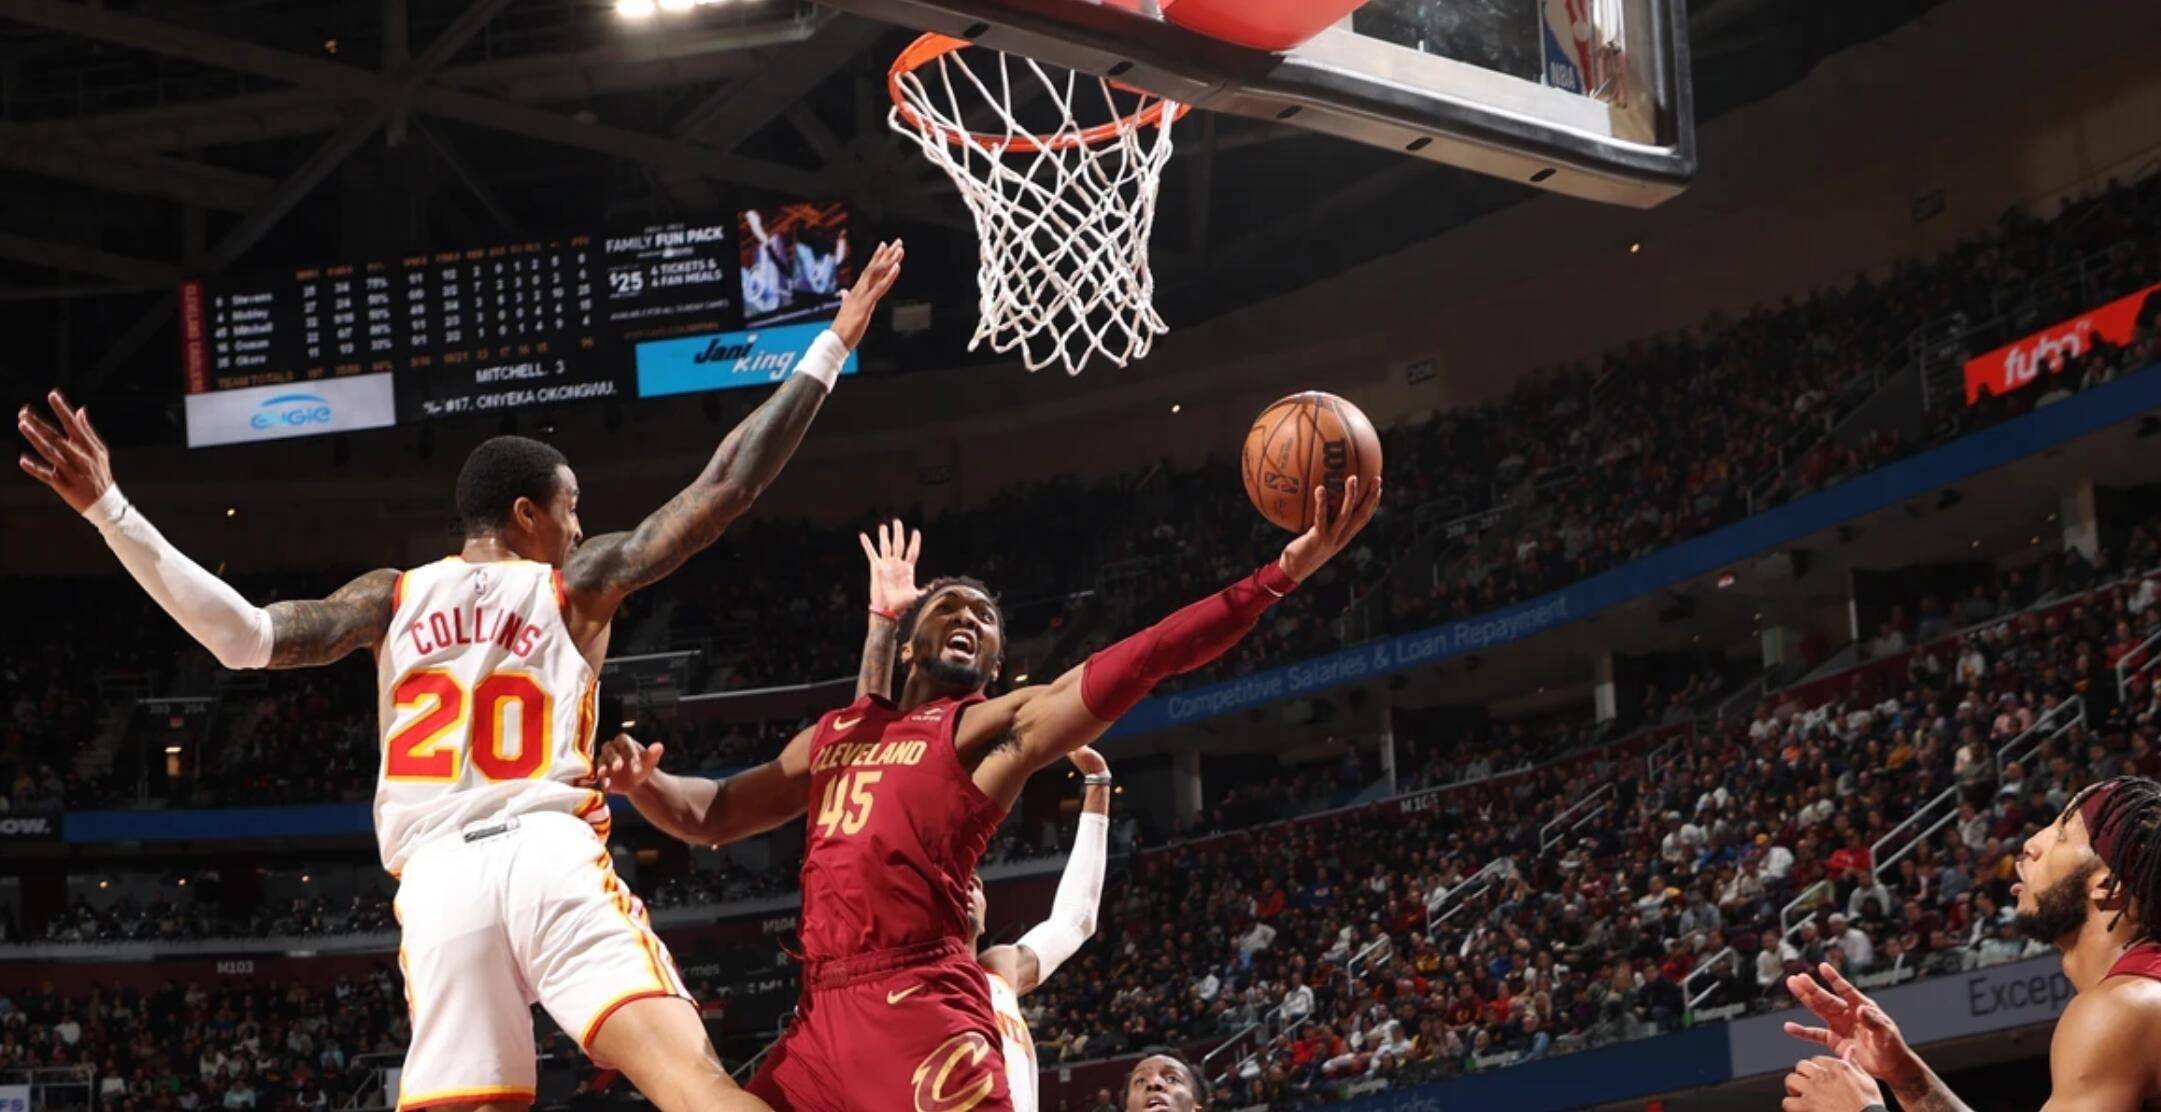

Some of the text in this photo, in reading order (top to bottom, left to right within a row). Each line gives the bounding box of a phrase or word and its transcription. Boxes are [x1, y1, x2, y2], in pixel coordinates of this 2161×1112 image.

[1551, 62, 1576, 88] NBA
[606, 235, 652, 253] FAMILY
[655, 231, 684, 247] FUN
[687, 226, 723, 243] PACK
[660, 259, 705, 274] TICKETS
[708, 257, 717, 270] &
[609, 270, 644, 292] $25
[661, 274, 684, 286] FAN
[685, 268, 723, 283] MEALS
[232, 293, 273, 305] Stevens
[232, 309, 268, 321] Mobley
[535, 320, 543, 332] 4
[582, 313, 590, 326] 4
[232, 322, 273, 336] Mitchell
[694, 333, 758, 364] Jani
[556, 359, 565, 374] 3
[217, 371, 294, 389] TEAM TOTALS
[476, 389, 535, 410] ONYEKA
[410, 607, 542, 658] COLLINS
[1168, 596, 1569, 720] Competitive Salaries & Loan Repayment
[385, 667, 554, 784] 20
[811, 740, 928, 775] CLEVELAND
[817, 771, 883, 838] 45
[217, 960, 254, 975] M103
